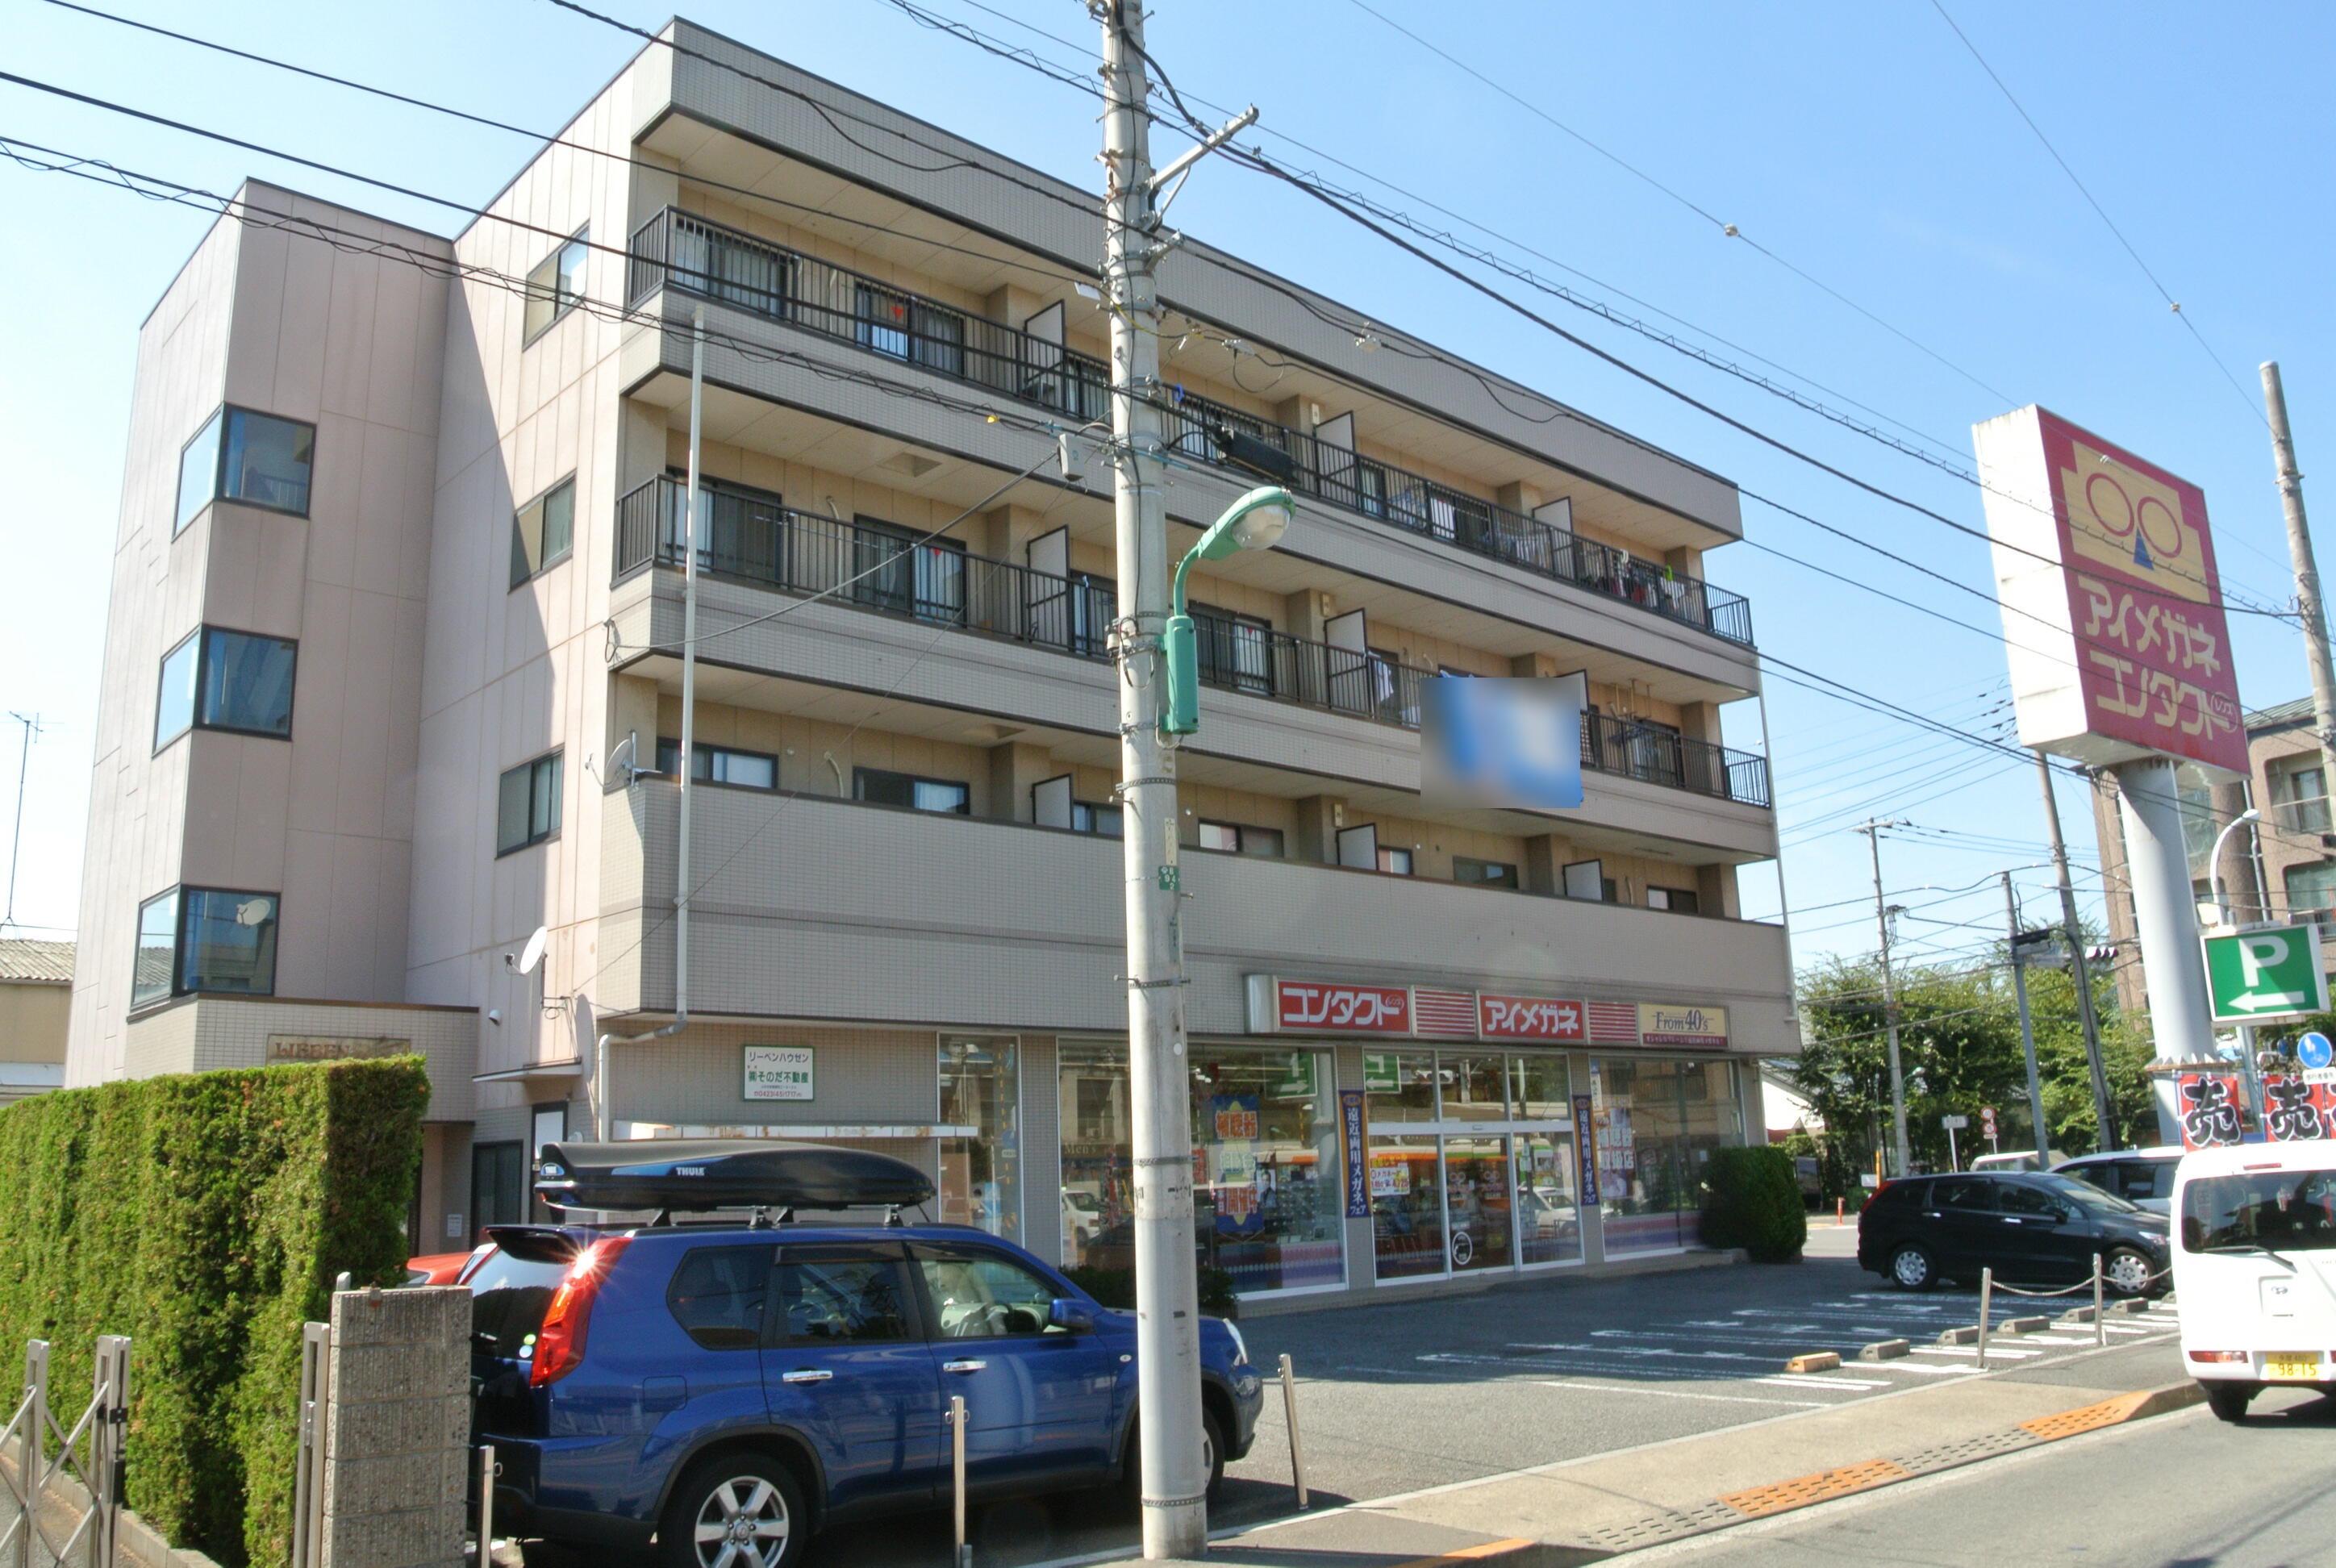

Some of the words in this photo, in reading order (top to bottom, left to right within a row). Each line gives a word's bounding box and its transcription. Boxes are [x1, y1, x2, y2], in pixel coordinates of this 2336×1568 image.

[2078, 575, 2221, 678] アイメガネ
[2089, 649, 2230, 740] コンタクト
[2238, 935, 2289, 987] P
[1282, 986, 1400, 1026] コンタクト
[1485, 999, 1579, 1036] アイメガネ
[1655, 1011, 1684, 1030] From
[1685, 1008, 1708, 1032] 40's
[749, 1051, 809, 1064] リーベンハウゼン
[676, 1167, 705, 1176] THULE
